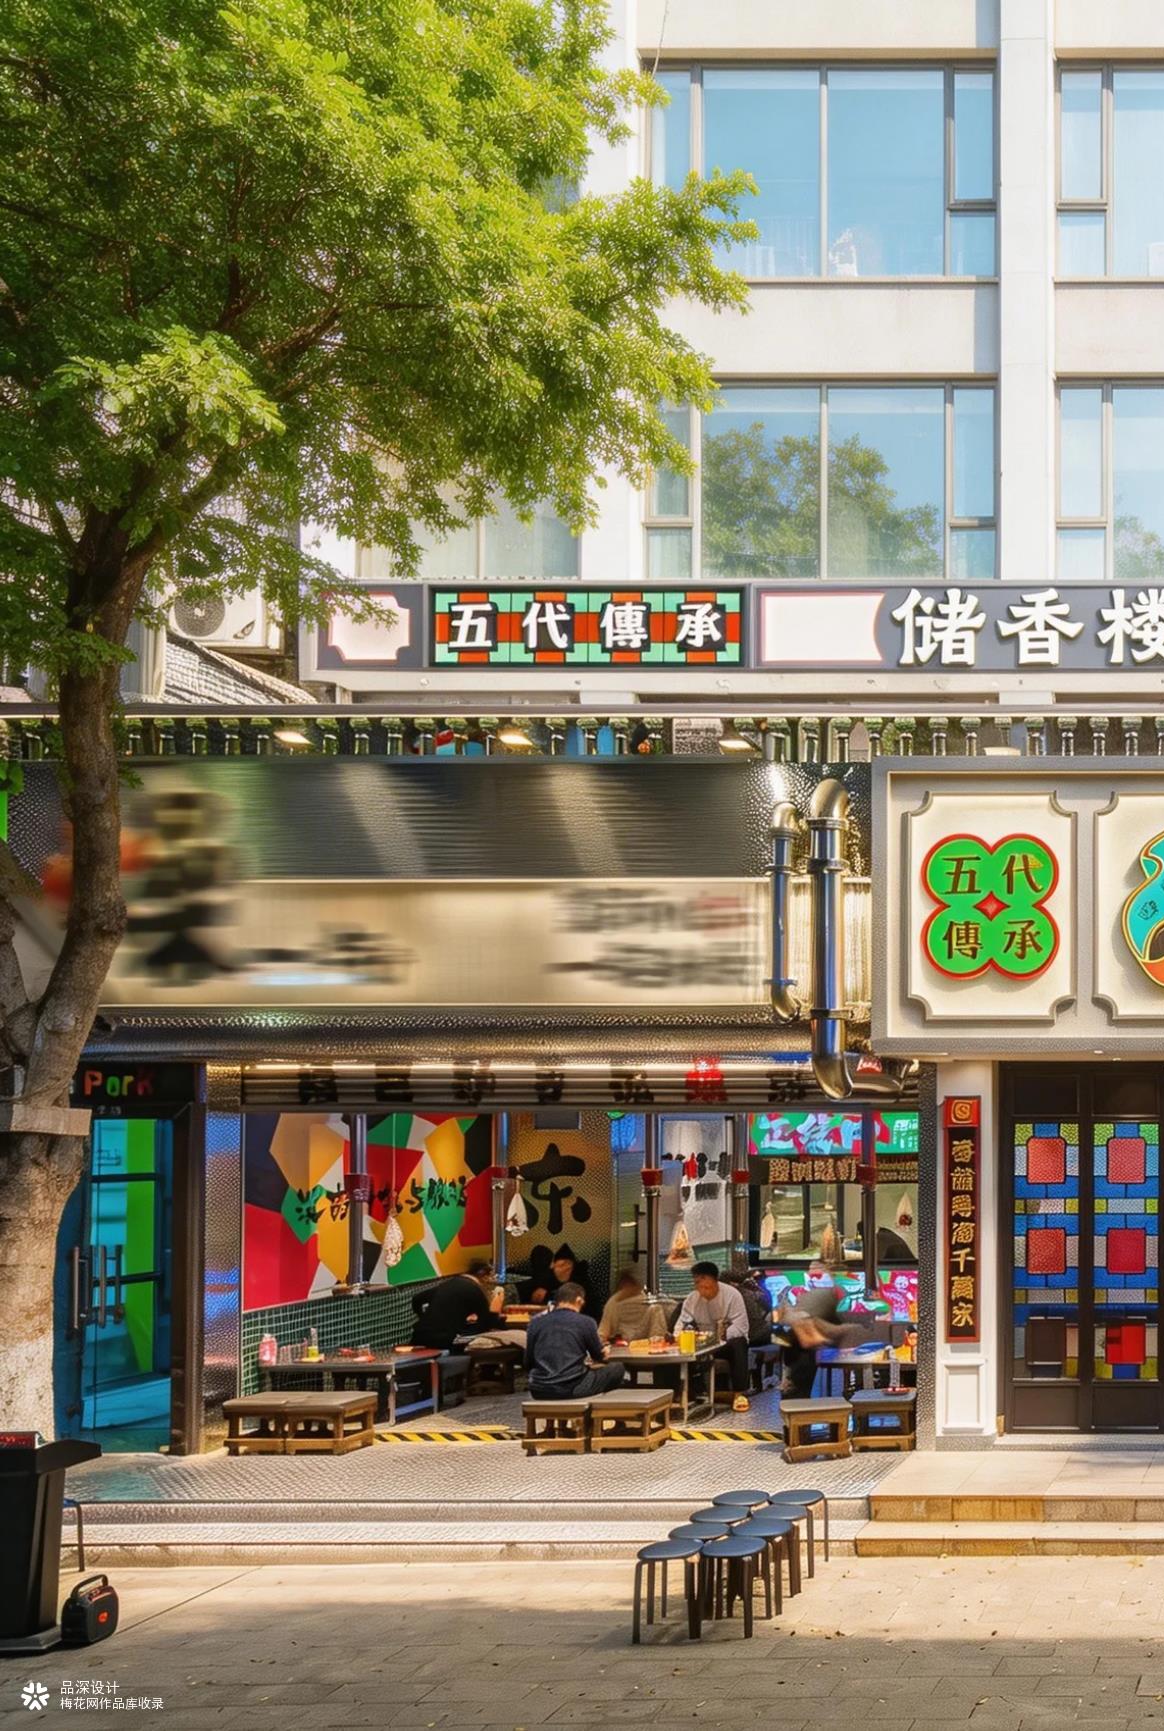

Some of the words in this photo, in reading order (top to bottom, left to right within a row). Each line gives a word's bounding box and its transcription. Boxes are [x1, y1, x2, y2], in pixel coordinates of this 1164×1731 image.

[447, 601, 723, 649] 五代傳承
[940, 854, 1044, 896] 五代
[941, 919, 1044, 961] 傳承
